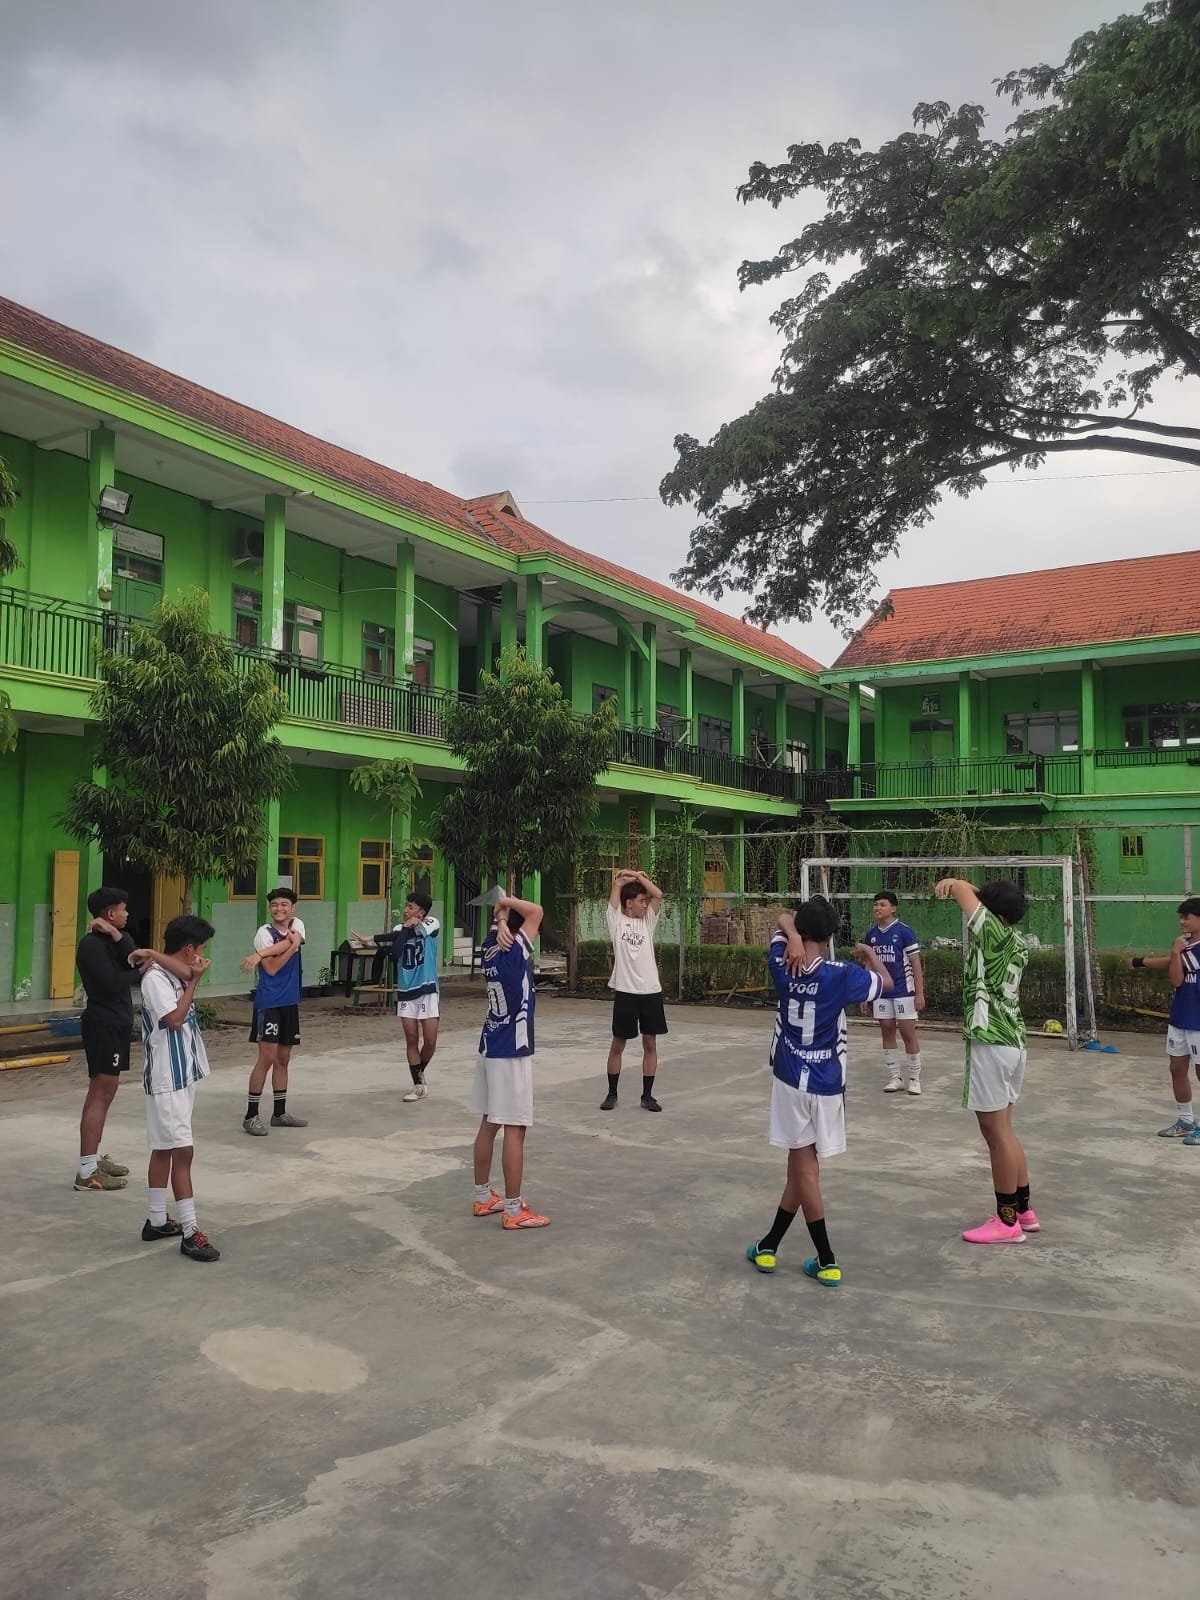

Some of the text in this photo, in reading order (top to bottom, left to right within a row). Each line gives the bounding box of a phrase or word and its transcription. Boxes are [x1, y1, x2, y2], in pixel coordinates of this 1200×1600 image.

[788, 982, 819, 995] YOGI
[787, 998, 816, 1045] 4
[265, 1022, 279, 1036] 29
[112, 1053, 120, 1067] 3
